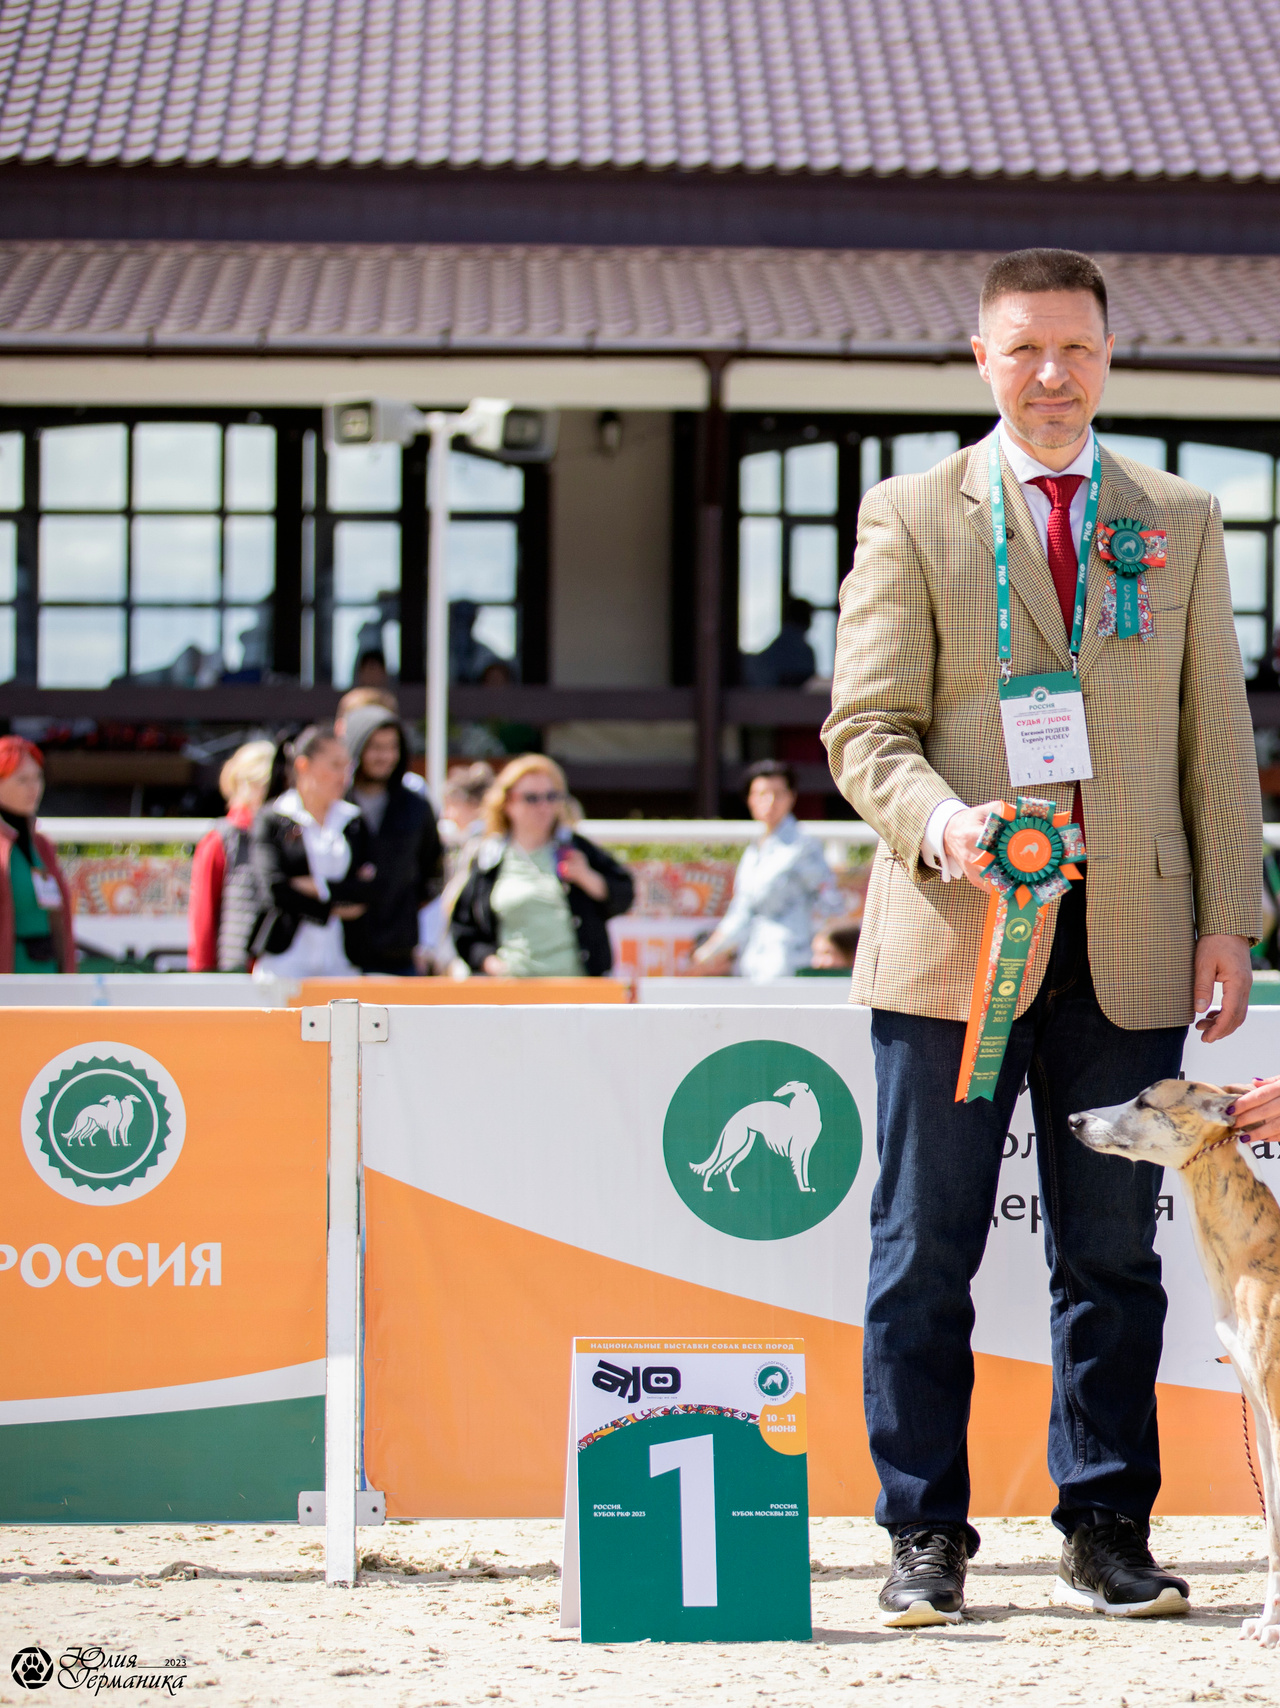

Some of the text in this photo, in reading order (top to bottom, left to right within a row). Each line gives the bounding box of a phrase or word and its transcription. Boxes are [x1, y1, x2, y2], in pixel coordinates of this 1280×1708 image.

[998, 565, 1006, 586] РКФ
[1078, 563, 1086, 584] РКФ
[1000, 608, 1008, 630] РКФ
[1074, 604, 1083, 626] РКФ
[1048, 715, 1072, 724] JUDGE
[766, 1414, 778, 1422] 10
[787, 1414, 796, 1422] 11
[766, 1424, 797, 1432] ИЮНЯ
[649, 1434, 718, 1607] 1
